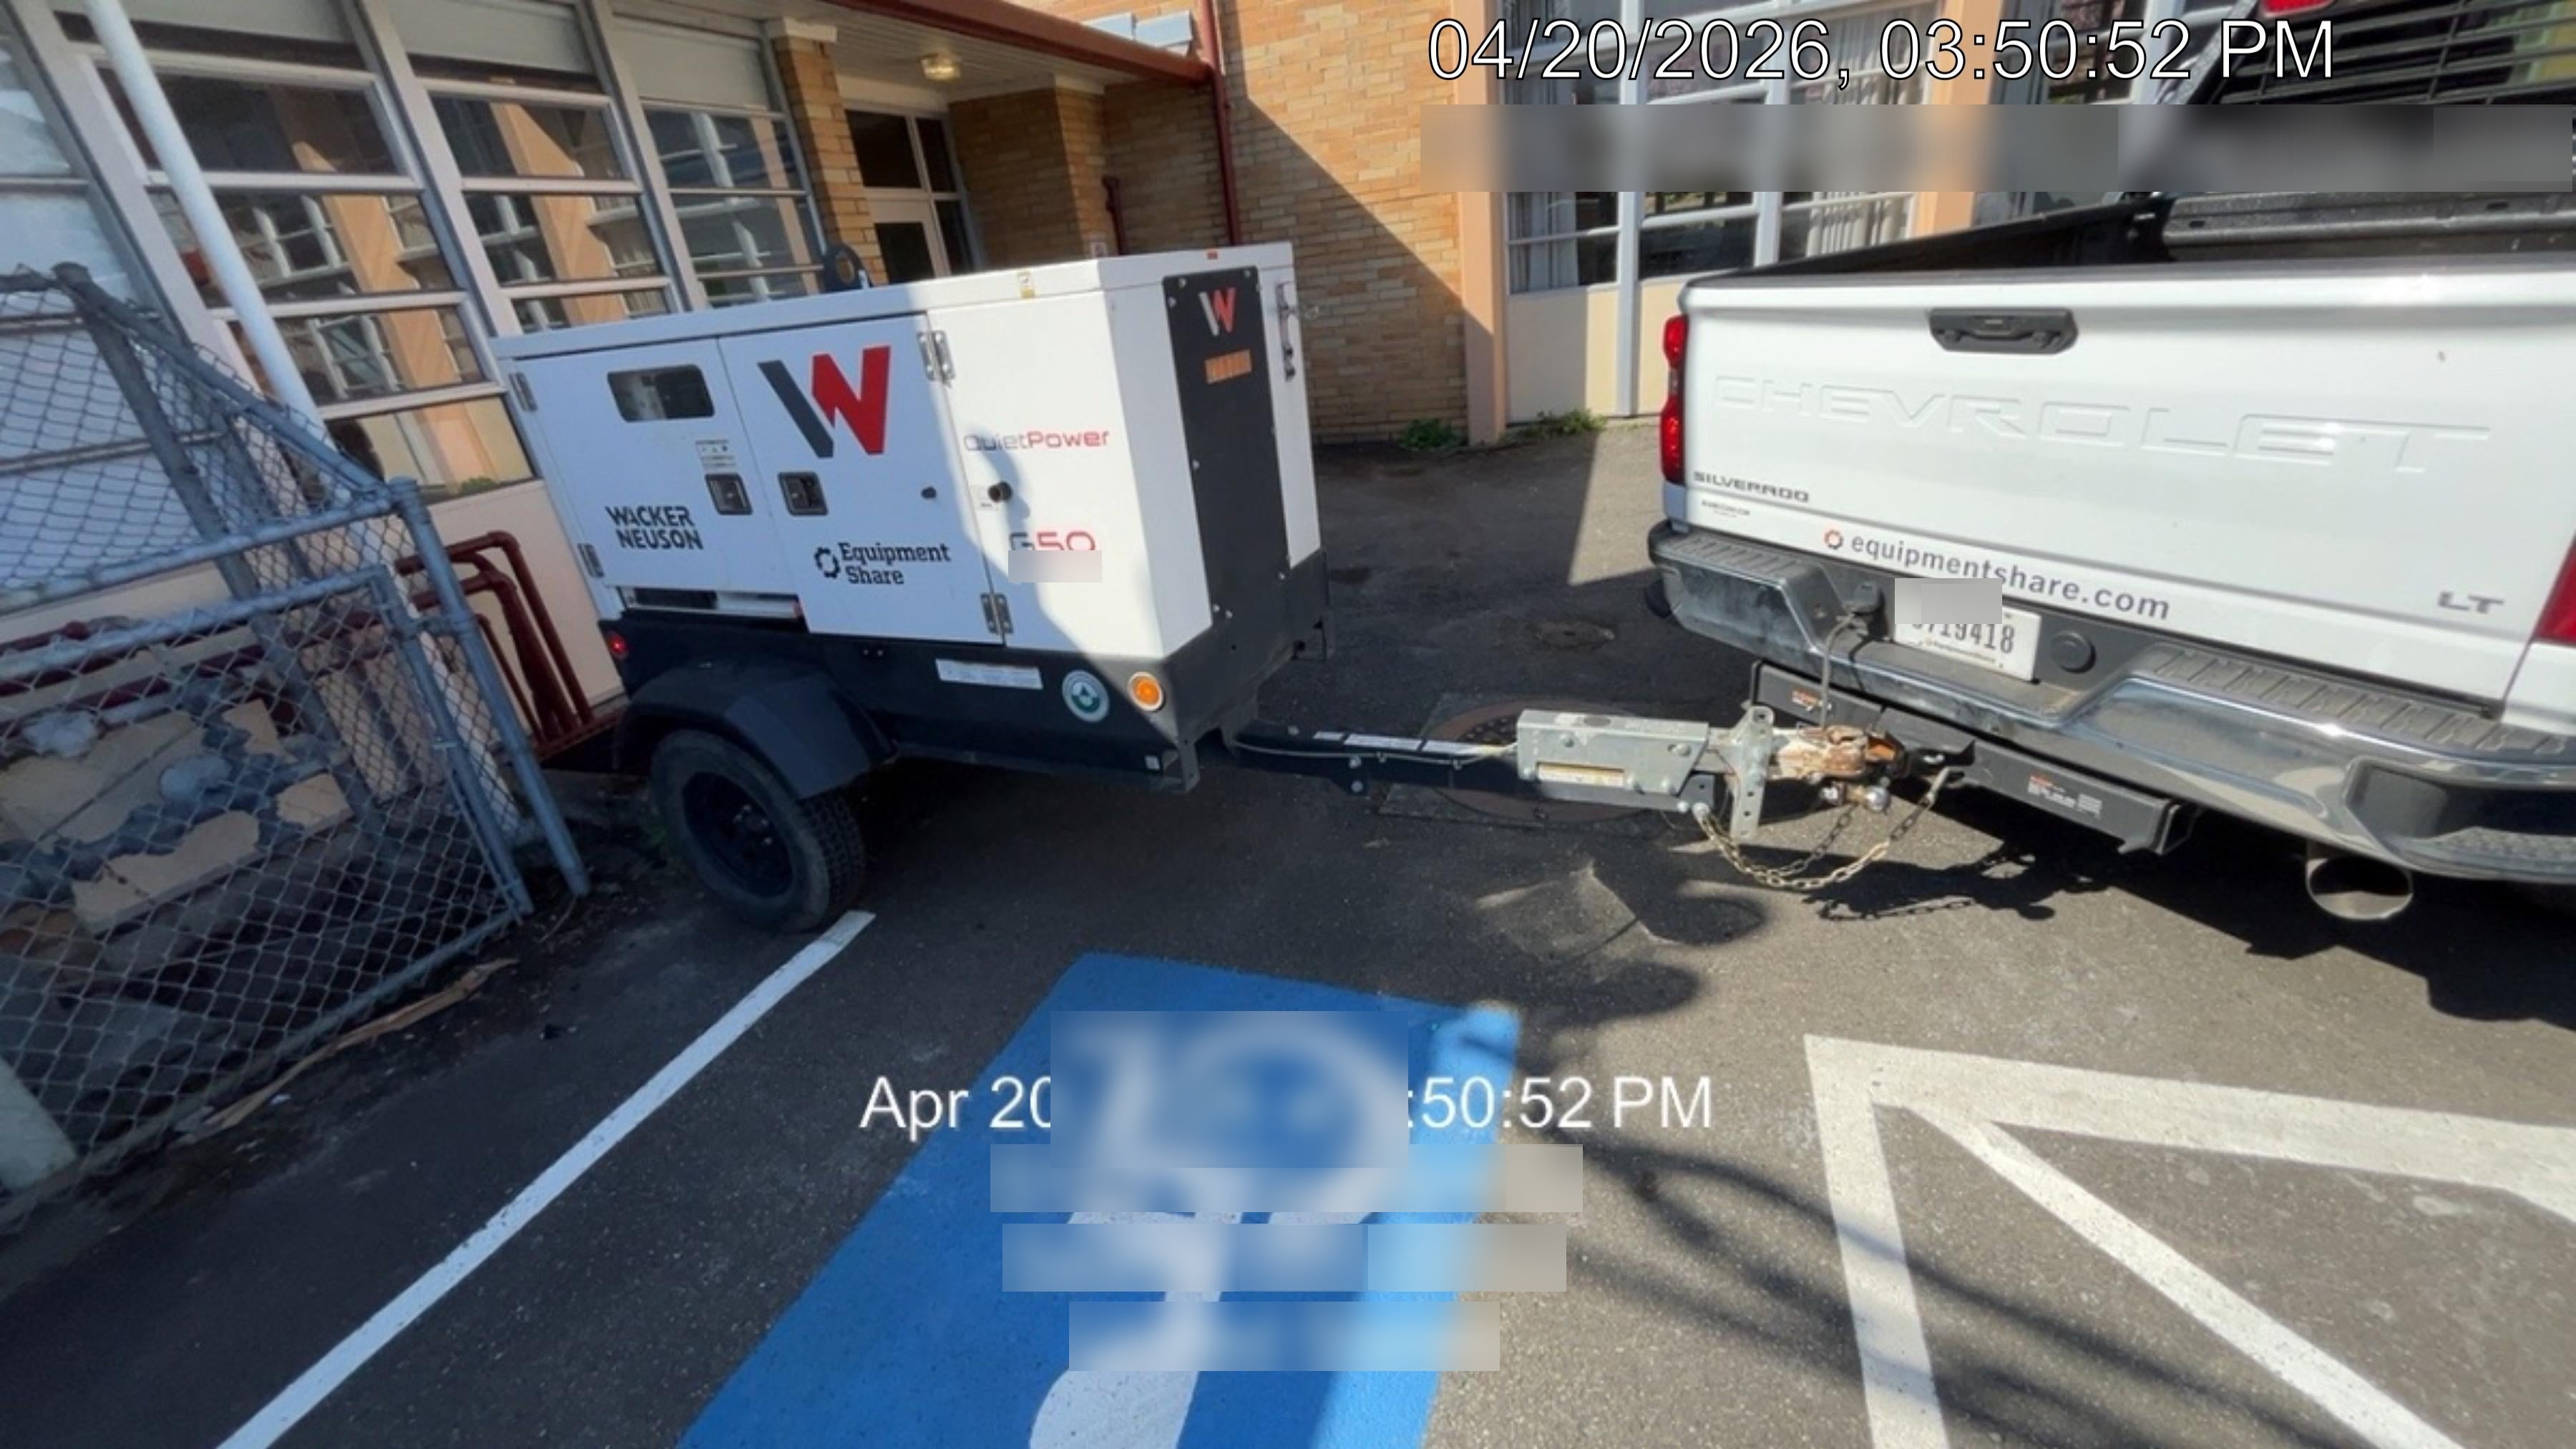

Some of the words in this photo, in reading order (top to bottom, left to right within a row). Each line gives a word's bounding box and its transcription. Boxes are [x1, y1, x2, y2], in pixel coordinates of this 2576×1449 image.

[757, 345, 891, 459] W
[1712, 374, 2492, 474] CHEVROLET
[964, 431, 1110, 451] QuietPower
[1694, 472, 1809, 503] SILVERADO
[605, 505, 696, 527] WACKER
[615, 529, 704, 550] NEUSON
[838, 542, 952, 566] Equipment
[845, 565, 904, 585] Share
[1850, 533, 2170, 620] equipmentshare.com
[2437, 590, 2506, 615] LT
[1912, 624, 2015, 653] 9418
